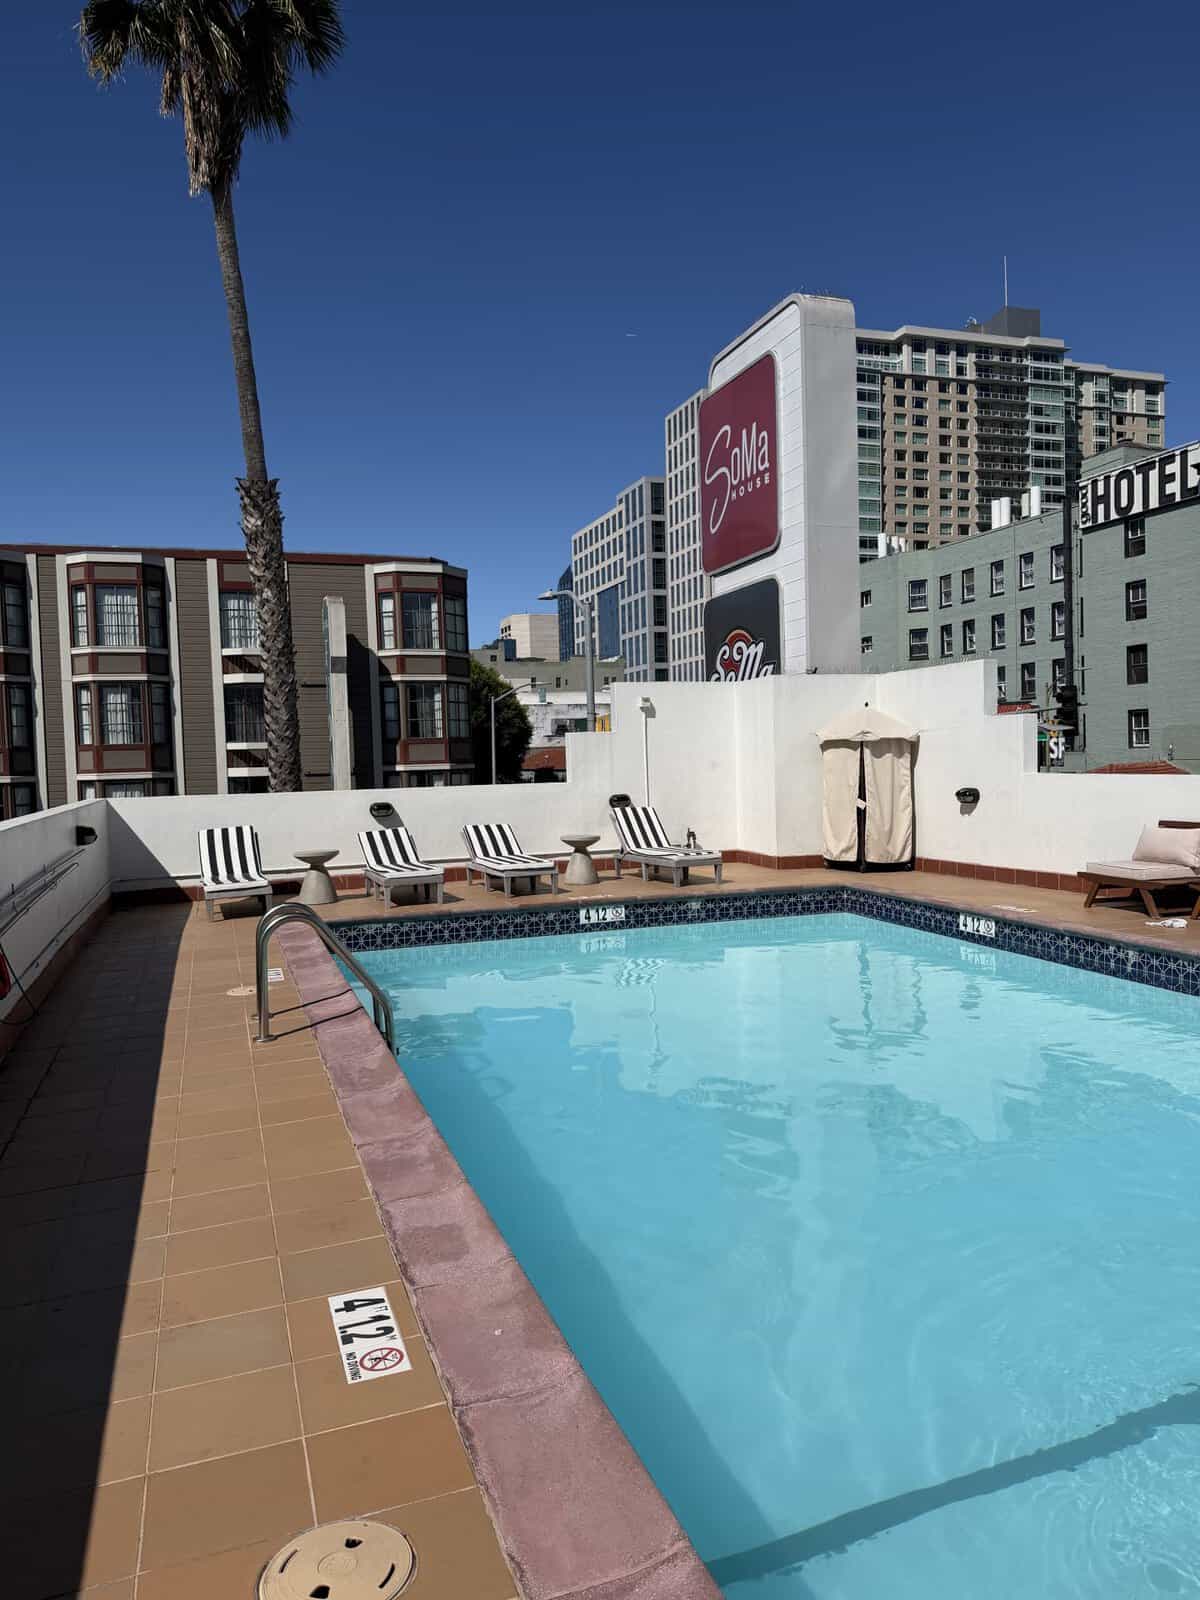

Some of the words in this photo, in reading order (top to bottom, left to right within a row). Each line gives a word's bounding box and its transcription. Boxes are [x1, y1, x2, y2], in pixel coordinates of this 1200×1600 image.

[705, 421, 769, 534] SoMa
[731, 472, 769, 501] HOUSE
[1091, 449, 1198, 525] HOTEL
[584, 908, 591, 923] 4
[962, 913, 968, 930] 4
[334, 1298, 386, 1313] 4
